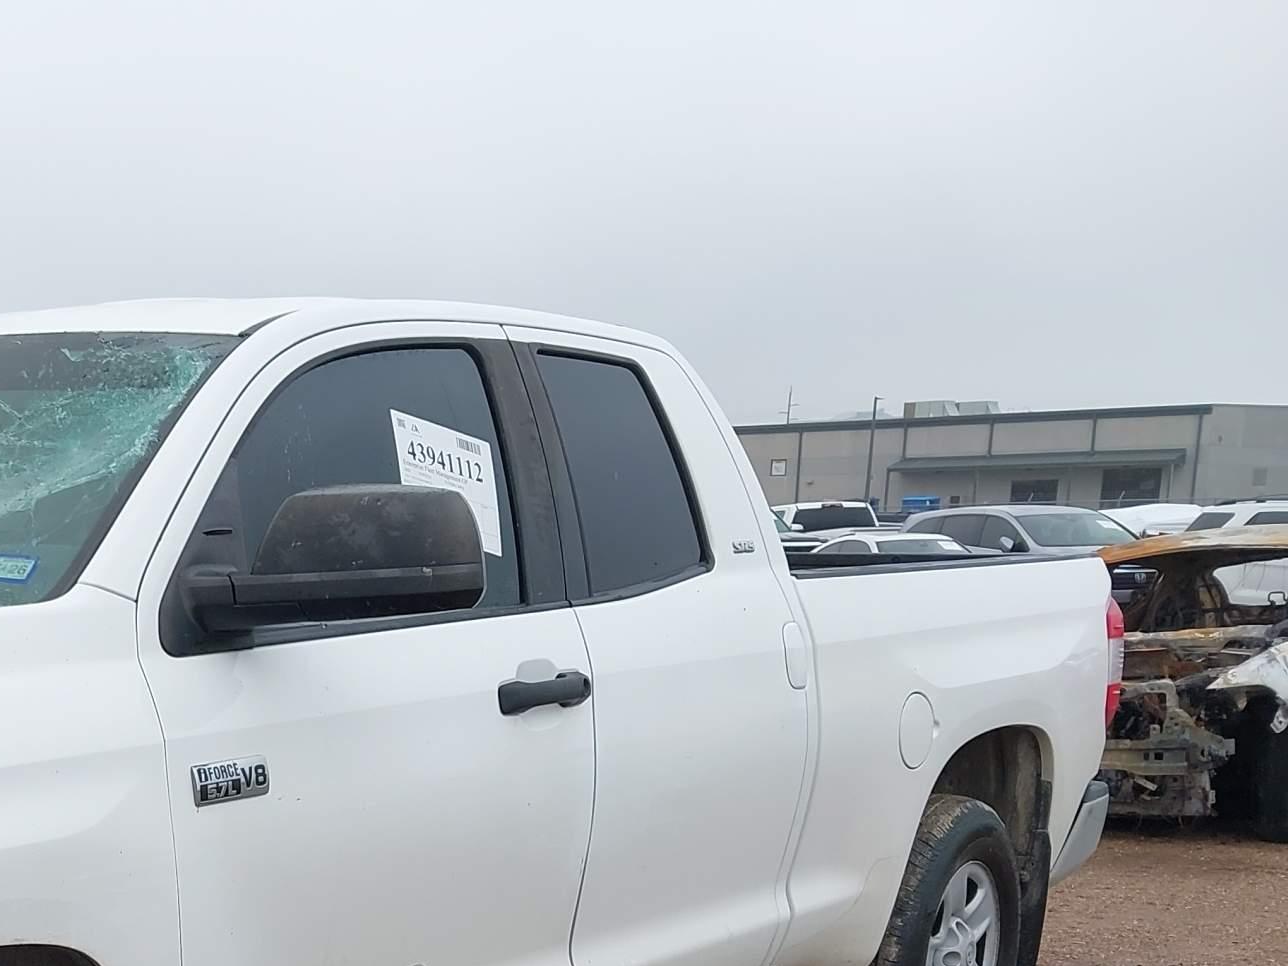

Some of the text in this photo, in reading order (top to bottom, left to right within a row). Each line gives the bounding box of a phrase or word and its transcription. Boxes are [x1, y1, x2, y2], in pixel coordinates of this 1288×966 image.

[407, 440, 483, 482] 43941112
[241, 764, 267, 788] V8
[206, 780, 238, 800] 5.7L
